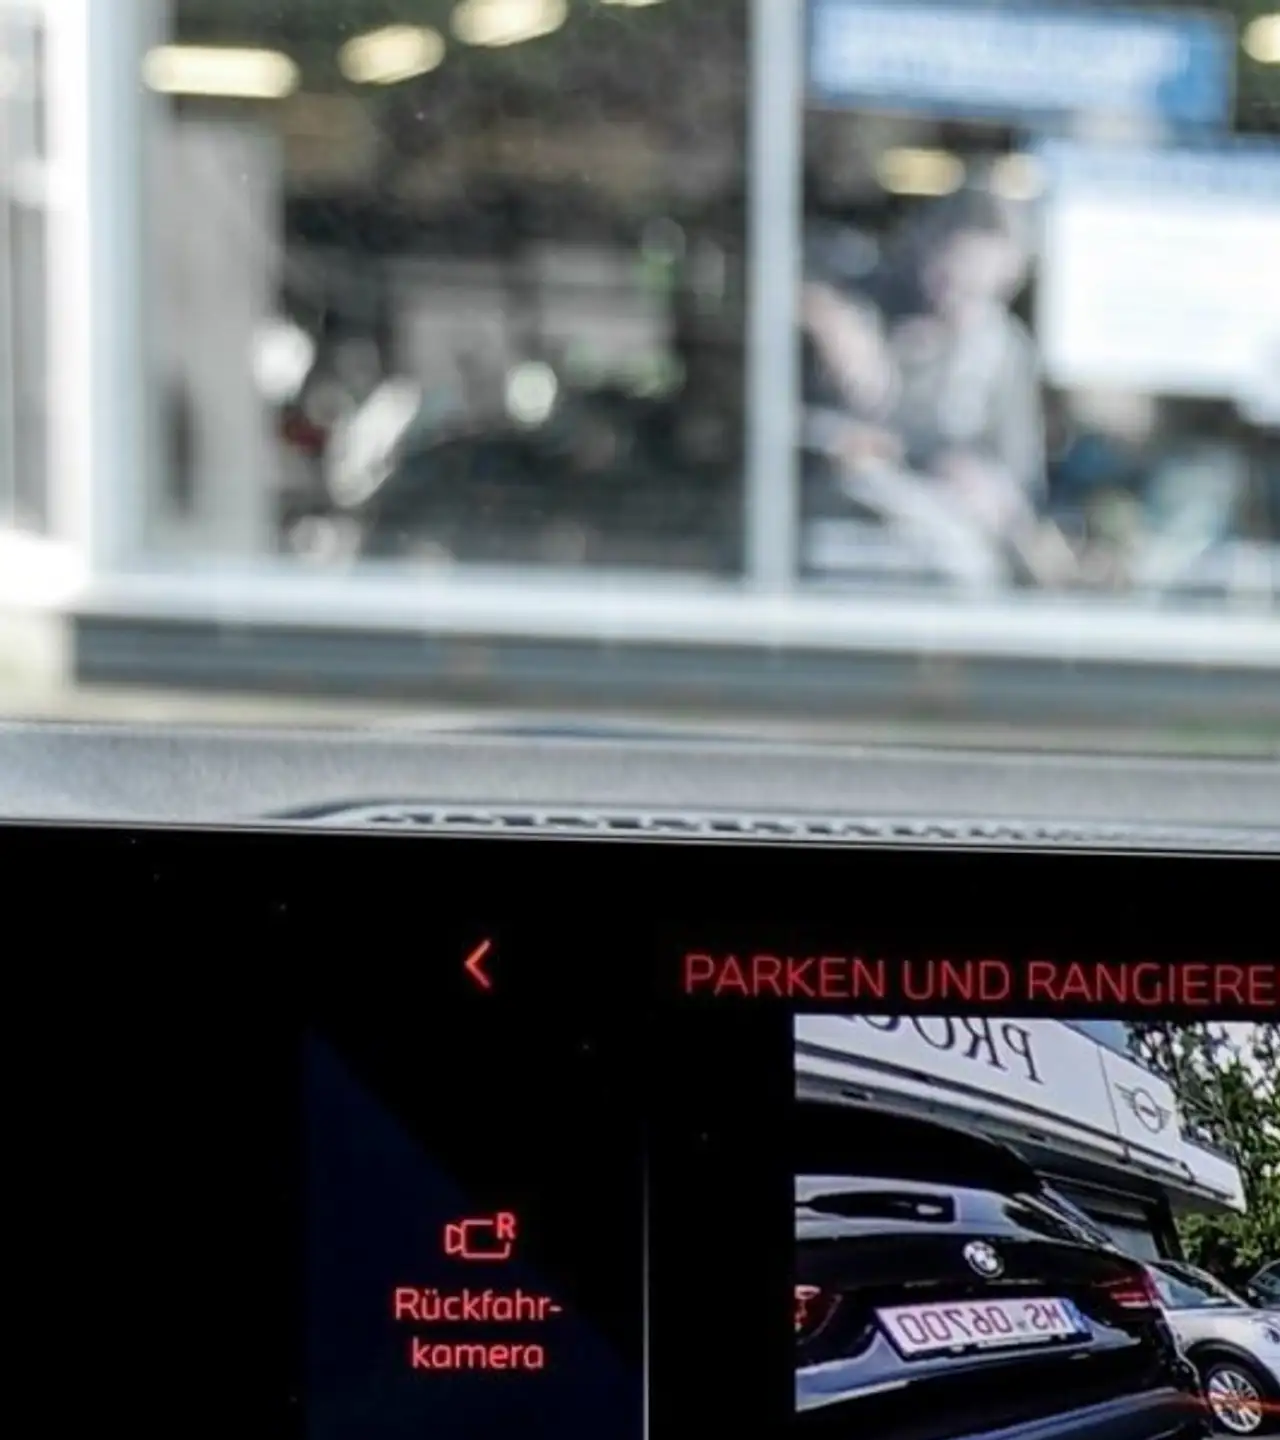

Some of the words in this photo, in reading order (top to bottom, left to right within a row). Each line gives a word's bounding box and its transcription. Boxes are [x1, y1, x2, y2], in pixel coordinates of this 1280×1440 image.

[685, 955, 885, 998] PARKEN
[903, 960, 1011, 1001] UND
[394, 1287, 562, 1322] Rückfahr-
[412, 1337, 545, 1370] kamera
